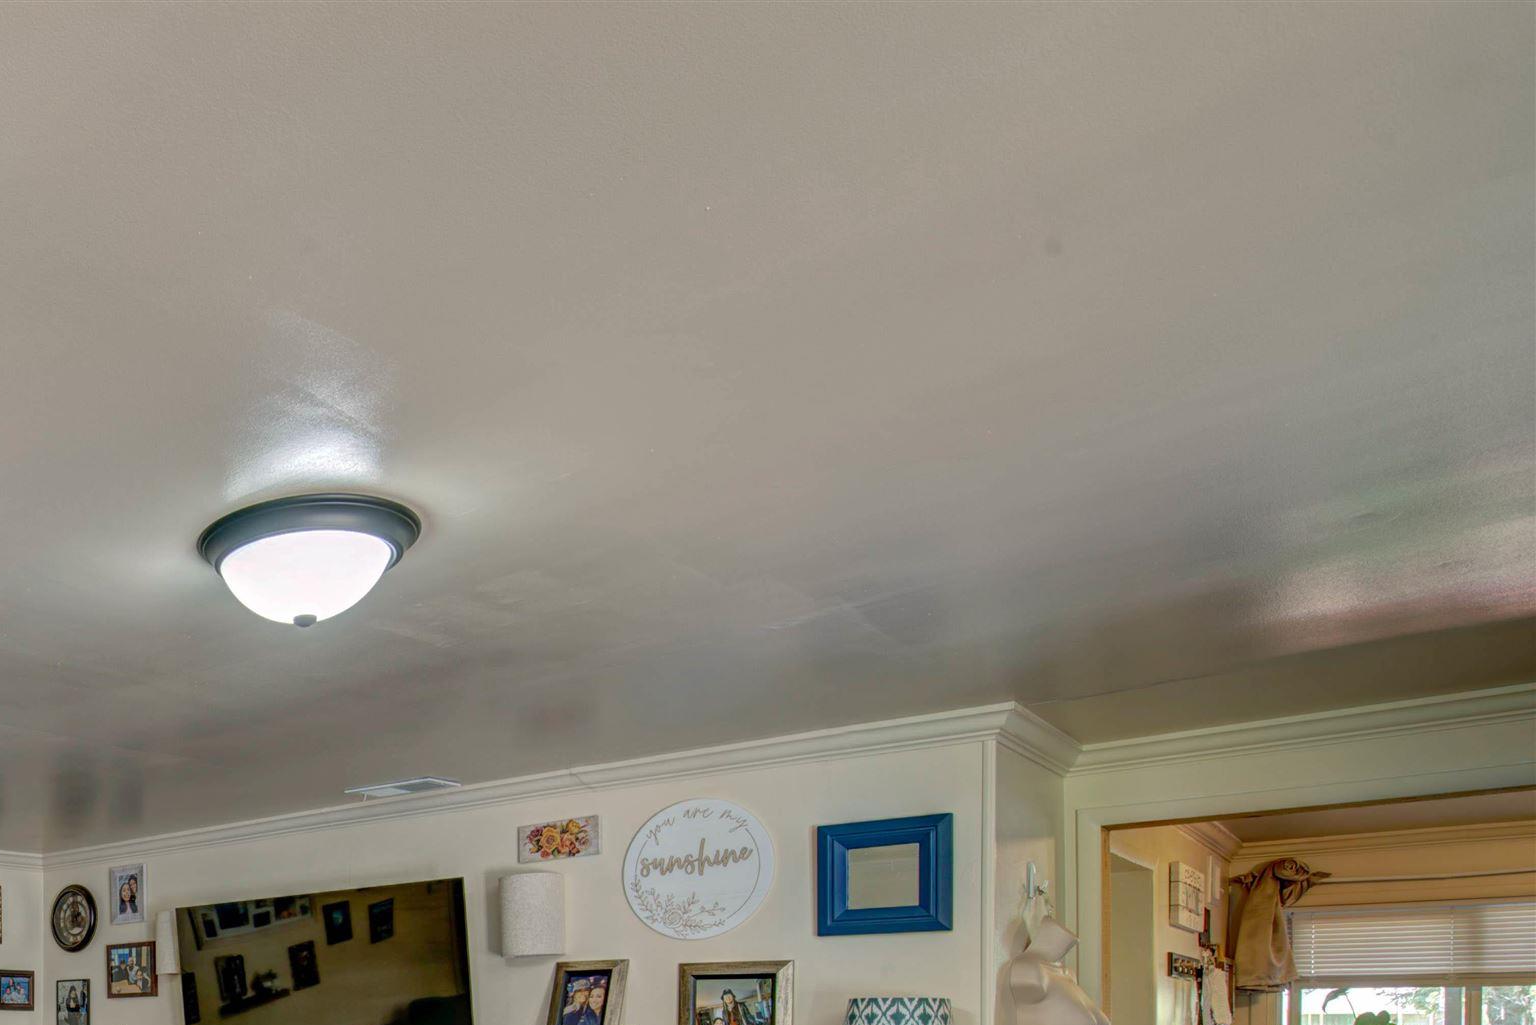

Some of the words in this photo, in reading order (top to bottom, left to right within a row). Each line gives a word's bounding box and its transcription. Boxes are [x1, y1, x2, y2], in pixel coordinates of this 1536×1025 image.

[647, 817, 675, 846] you
[682, 806, 714, 819] are
[719, 808, 749, 833] my
[639, 837, 754, 878] sunshine
